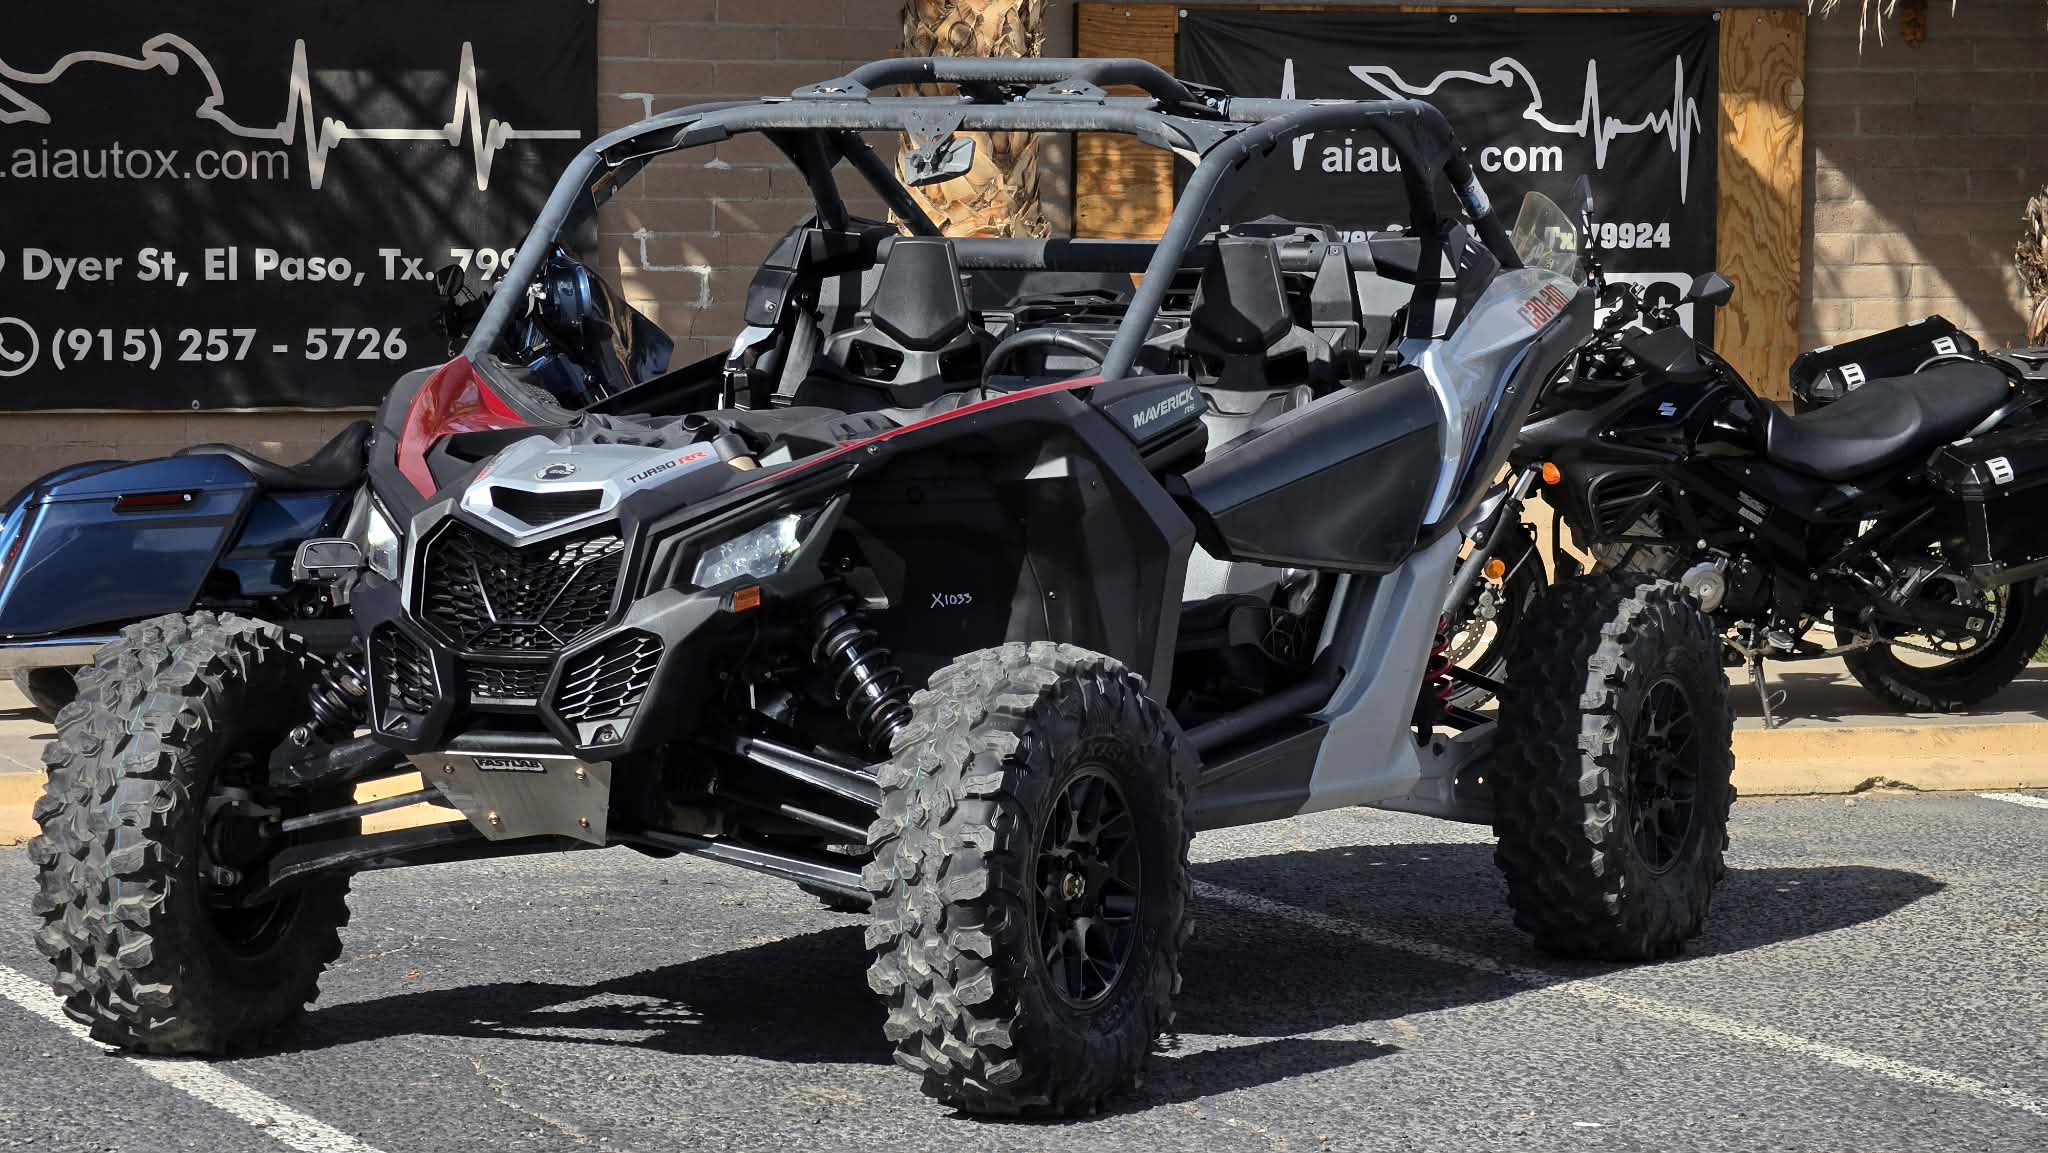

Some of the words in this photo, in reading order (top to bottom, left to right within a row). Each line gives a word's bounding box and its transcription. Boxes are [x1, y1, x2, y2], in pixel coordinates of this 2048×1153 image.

[23, 247, 123, 290] Dyer
[137, 247, 189, 287] St,
[205, 246, 238, 281] El
[255, 248, 365, 287] Paso,
[379, 248, 435, 281] Tx.
[52, 327, 162, 371] (915)
[178, 328, 257, 362] 257
[305, 327, 408, 361] 5726
[1132, 387, 1195, 430] MAVERICK
[627, 460, 677, 483] TURBO
[678, 451, 709, 465] RR
[480, 758, 541, 769] FASTLAB
